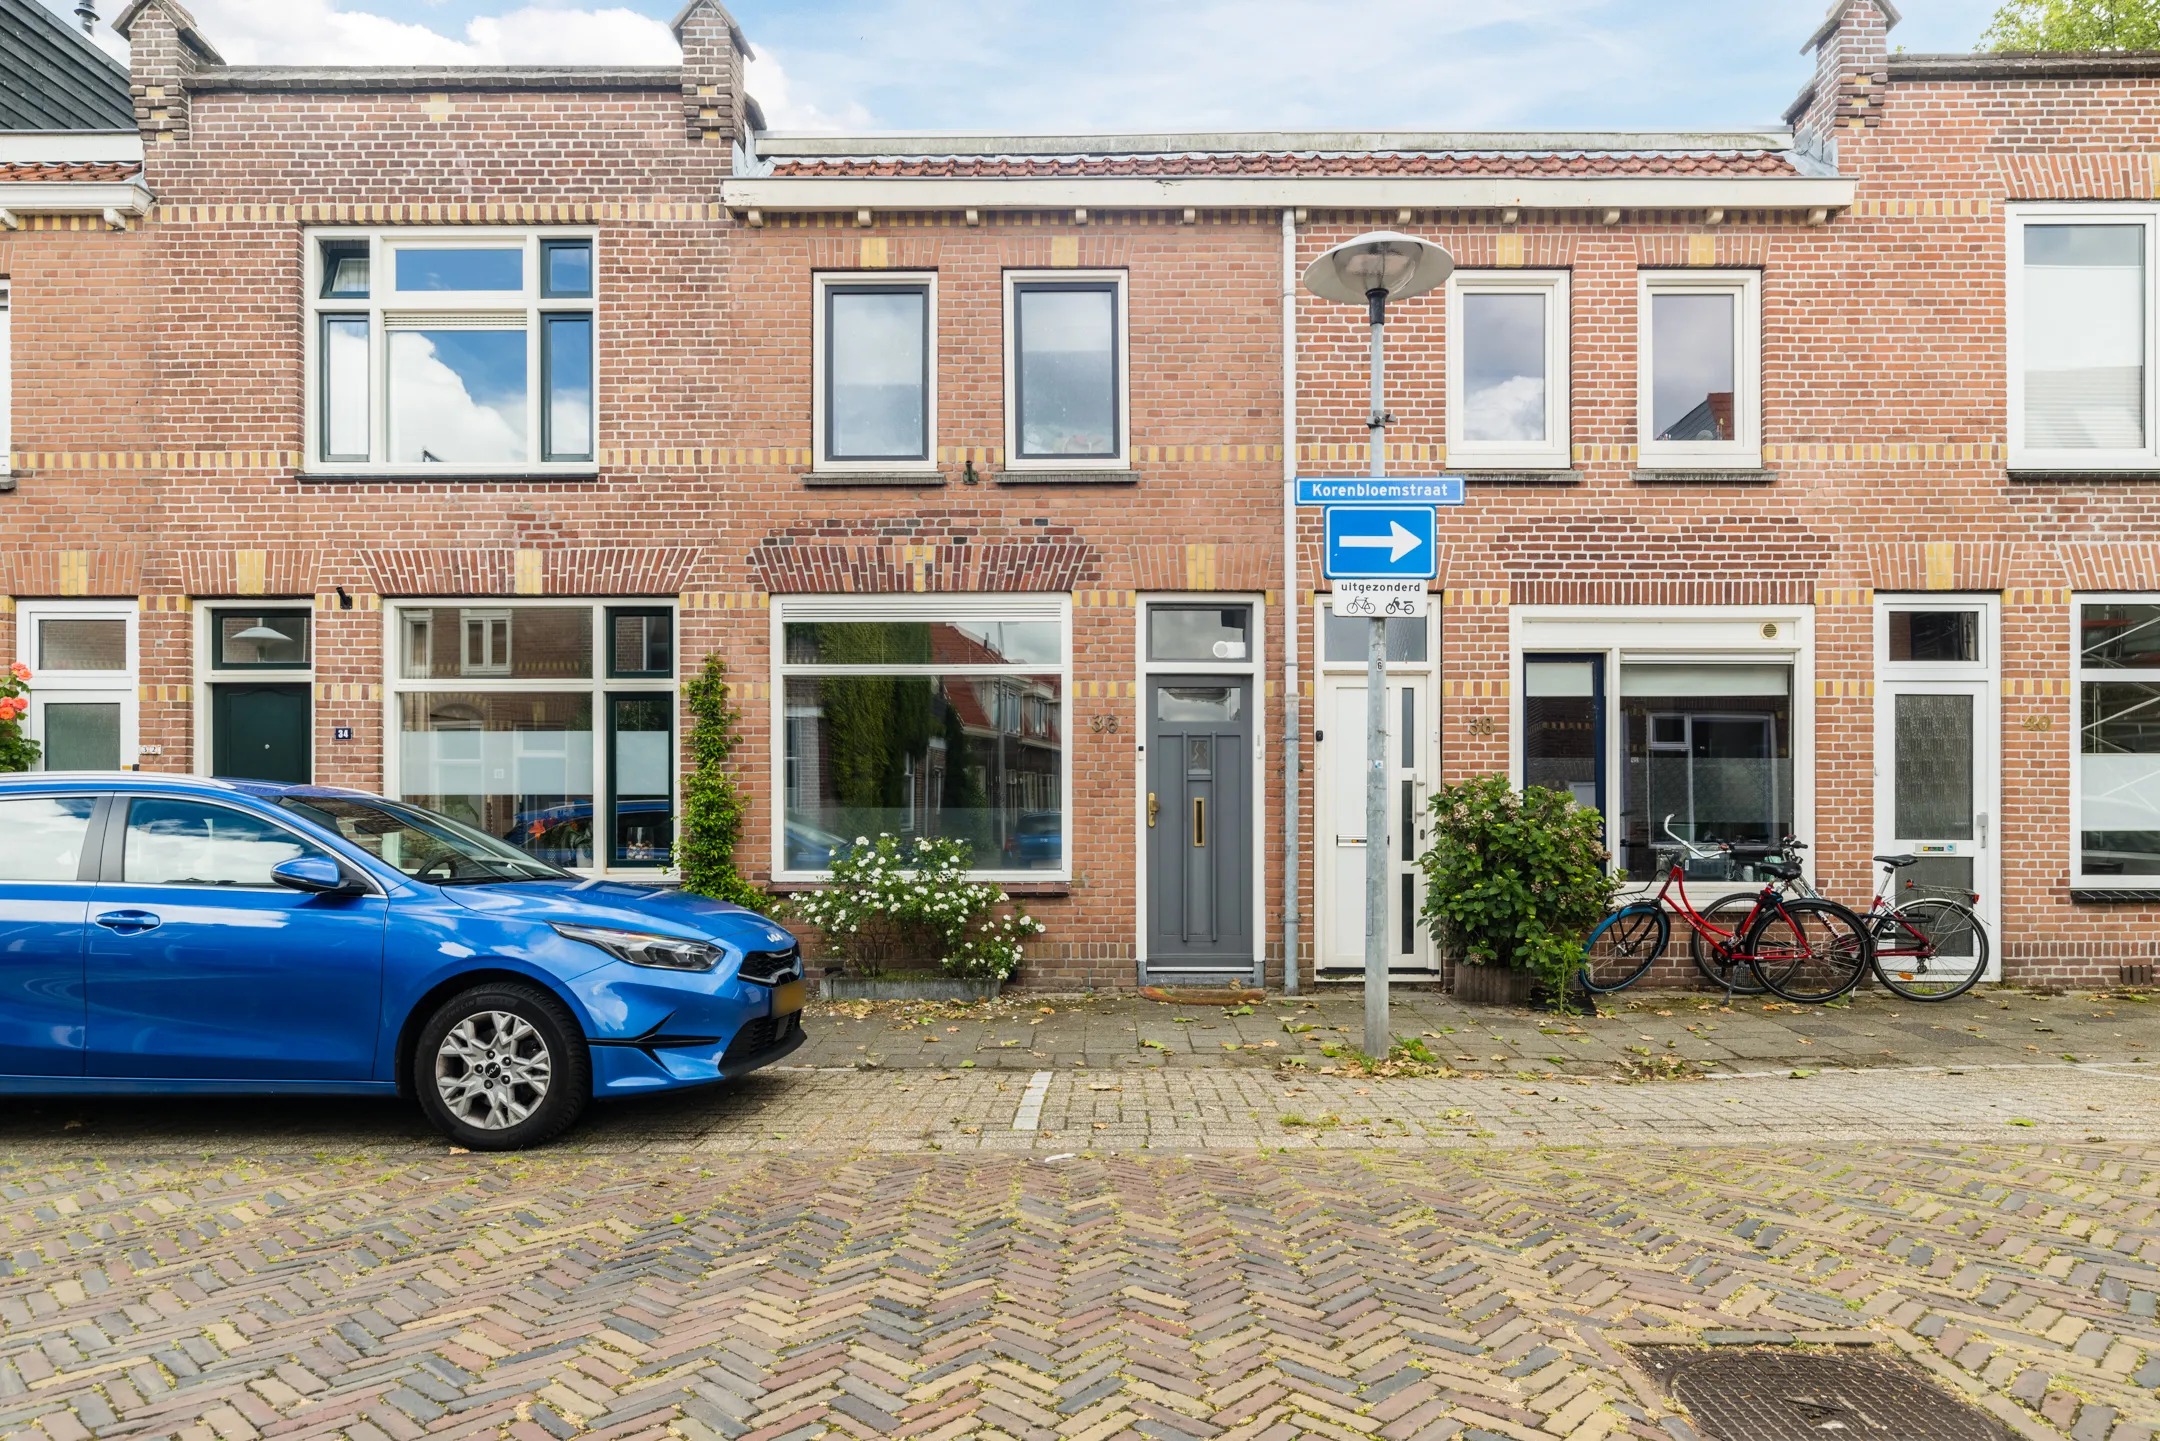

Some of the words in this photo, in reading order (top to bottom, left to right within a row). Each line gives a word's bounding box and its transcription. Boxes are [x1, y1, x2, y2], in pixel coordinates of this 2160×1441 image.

[1312, 483, 1448, 497] Korenbloemstraat
[1341, 582, 1420, 594] uitgezonderd
[1092, 714, 1118, 734] 36
[1469, 716, 1495, 736] 38
[2022, 715, 2051, 731] 40
[338, 729, 348, 738] 34
